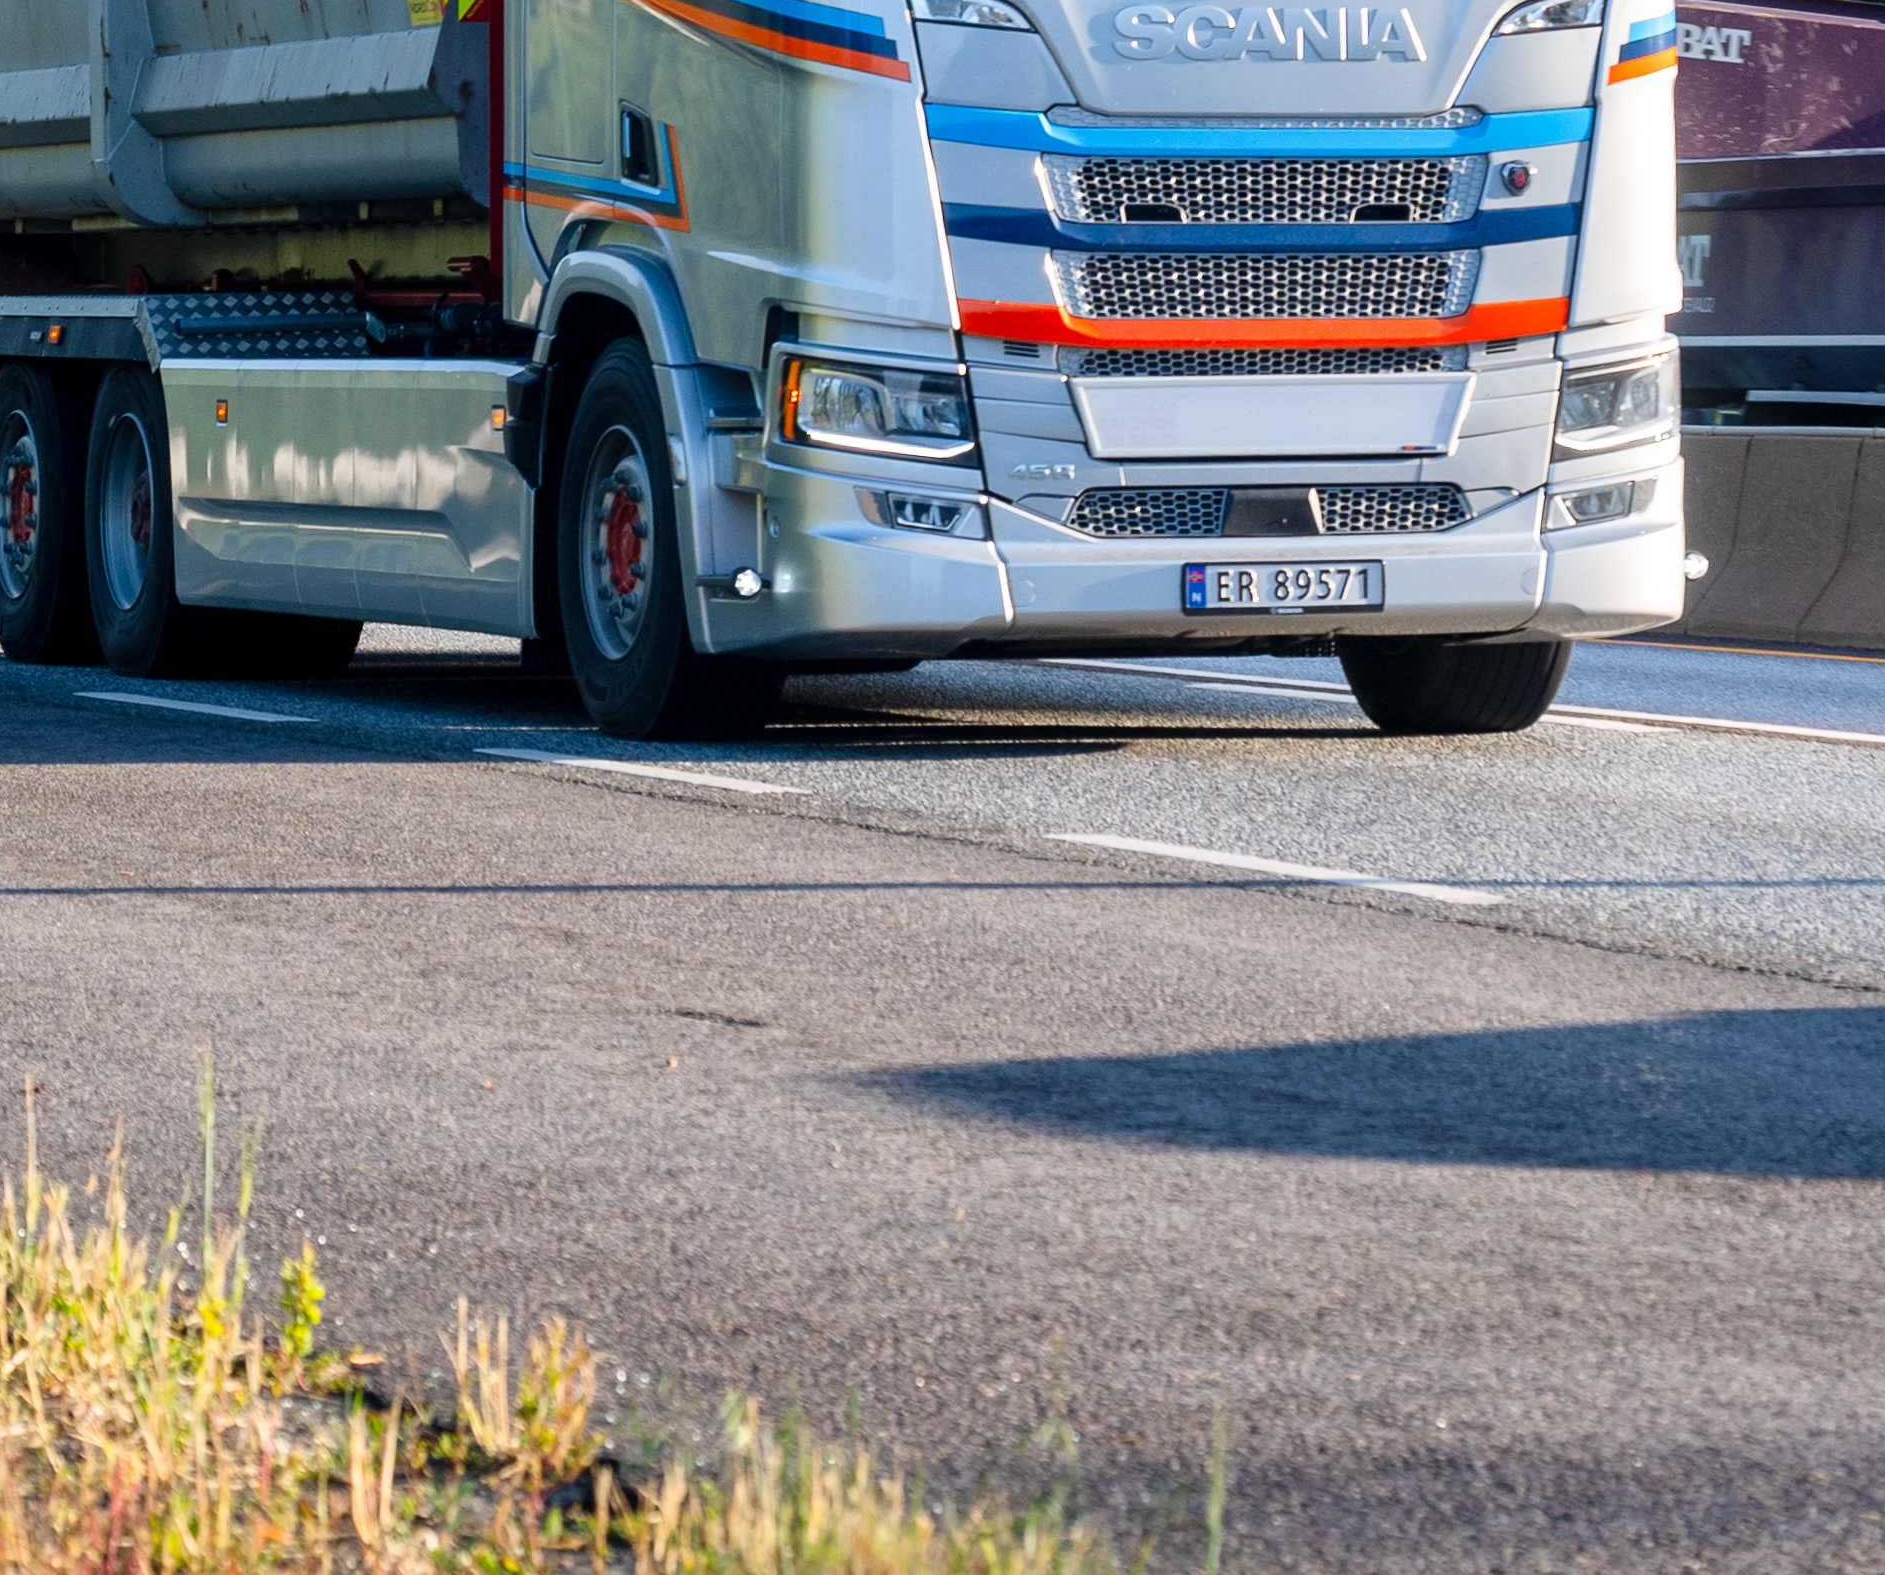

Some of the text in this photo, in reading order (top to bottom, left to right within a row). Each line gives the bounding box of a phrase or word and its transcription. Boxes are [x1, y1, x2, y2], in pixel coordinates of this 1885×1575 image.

[1112, 4, 1428, 64] SCANIA
[1676, 22, 1752, 64] BAT
[1217, 568, 1370, 603] ER 89571
